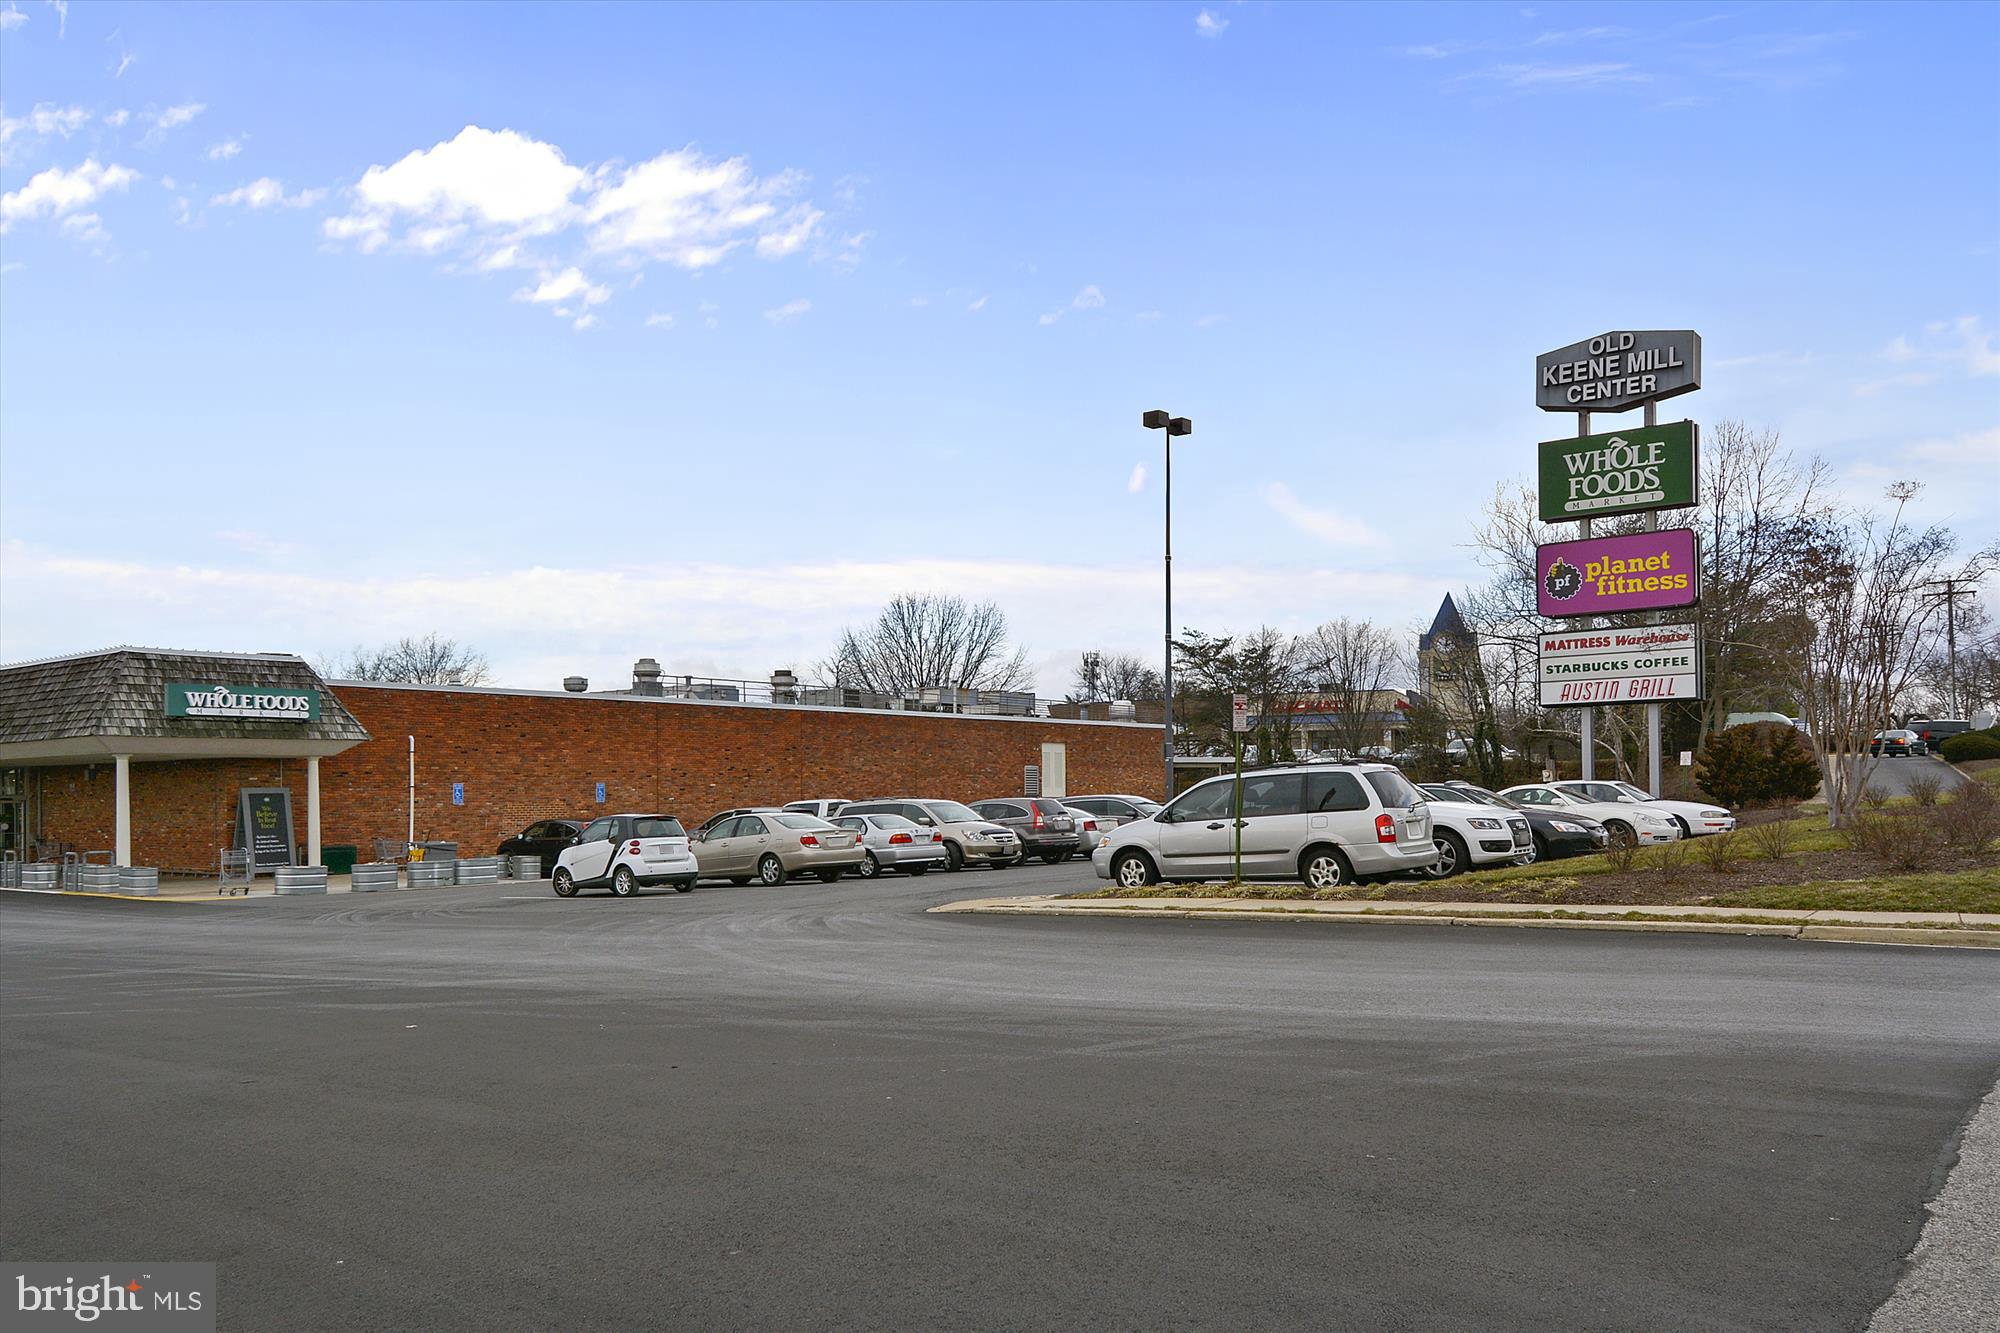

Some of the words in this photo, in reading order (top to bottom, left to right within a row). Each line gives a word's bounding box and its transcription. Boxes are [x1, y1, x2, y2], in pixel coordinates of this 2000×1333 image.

[1588, 332, 1635, 355] OLD
[1542, 355, 1620, 386] KEENE
[1627, 346, 1683, 374] MILL
[1566, 375, 1656, 404] CENTER
[1563, 437, 1666, 475] WHOLE
[1568, 466, 1661, 500] FOODS
[1572, 492, 1657, 510] MARKET
[1585, 551, 1670, 583] planet
[1554, 574, 1572, 591] pf
[1596, 573, 1688, 596] fitness
[1544, 636, 1611, 652] MATTRESS
[1615, 632, 1690, 647] Warehouse
[1546, 660, 1629, 675] STARBUCKS
[1634, 656, 1689, 669] COFFEE
[184, 686, 254, 709] WHOLE
[254, 695, 310, 711] FOODS
[1560, 680, 1620, 702] AUSTIN
[1628, 677, 1676, 699] GRILL
